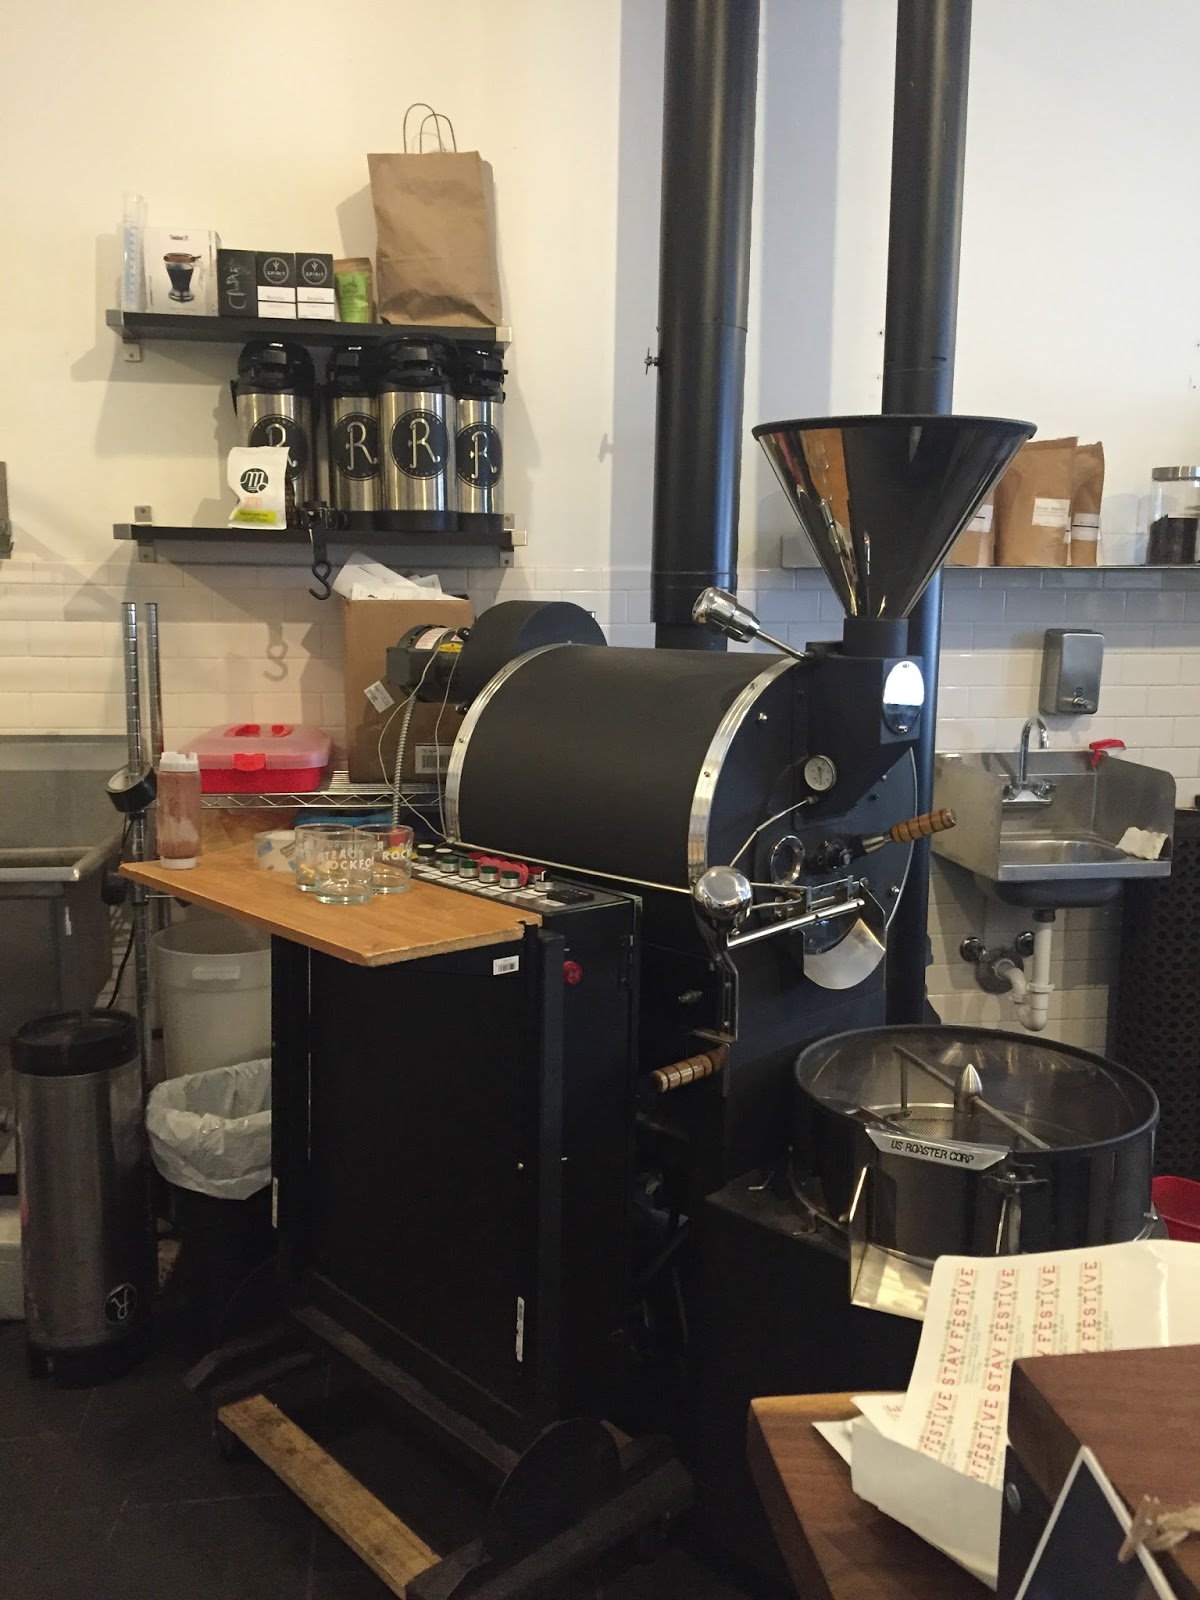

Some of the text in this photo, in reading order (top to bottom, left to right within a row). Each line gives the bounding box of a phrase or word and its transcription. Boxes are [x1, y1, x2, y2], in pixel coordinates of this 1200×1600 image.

[346, 421, 378, 471] R
[409, 418, 441, 469] R
[471, 430, 498, 479] R
[891, 1139, 974, 1164] US ROASTER CORP
[950, 1268, 974, 1339] FESTIVE
[994, 1269, 1015, 1342] FESTIVE
[1038, 1265, 1055, 1342] FESTIVE
[1082, 1261, 1098, 1341] FESTIVE
[942, 1345, 961, 1386] STAY
[987, 1348, 1005, 1392] STAY
[924, 1391, 952, 1453] FESTIVE
[972, 1400, 999, 1470] FESTIVE
